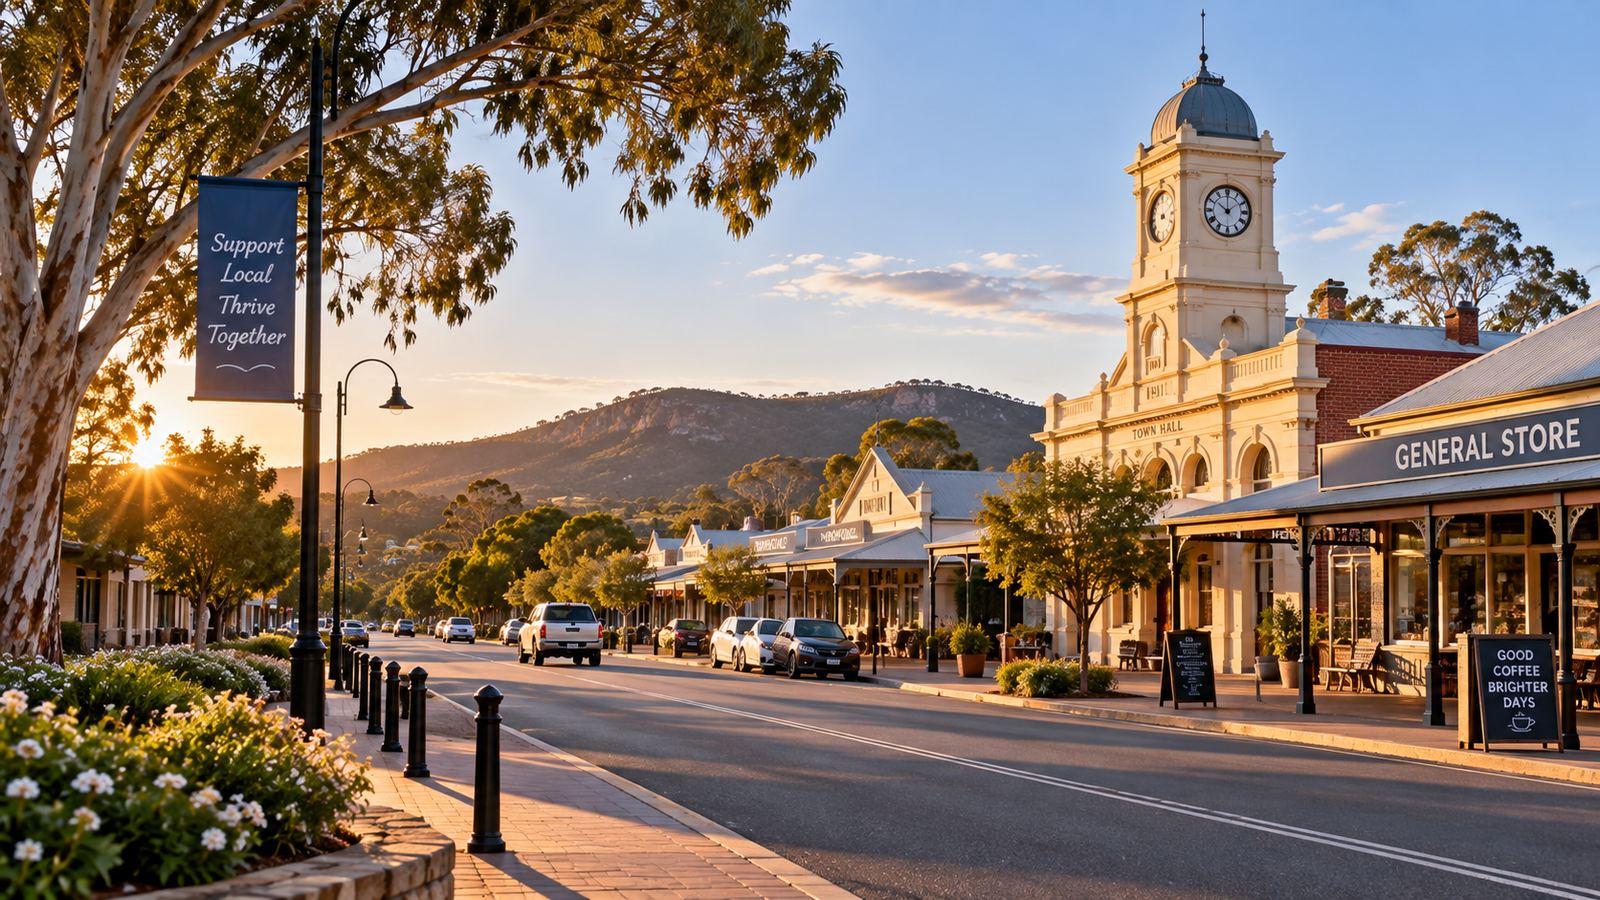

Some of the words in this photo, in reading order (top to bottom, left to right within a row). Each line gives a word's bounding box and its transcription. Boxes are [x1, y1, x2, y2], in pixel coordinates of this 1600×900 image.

[211, 233, 285, 259] Support
[220, 263, 275, 283] Local
[218, 294, 276, 316] Thrive
[207, 324, 287, 351] Together
[1132, 424, 1157, 440] TOWN
[1160, 420, 1184, 434] HALL
[1395, 432, 1494, 470] GENERAL
[1501, 418, 1581, 457] STORE
[1497, 649, 1534, 661] GOOD
[1493, 665, 1541, 677] COFFEE
[1488, 681, 1549, 693] BRIGHTER
[1503, 696, 1536, 708] DAYS
